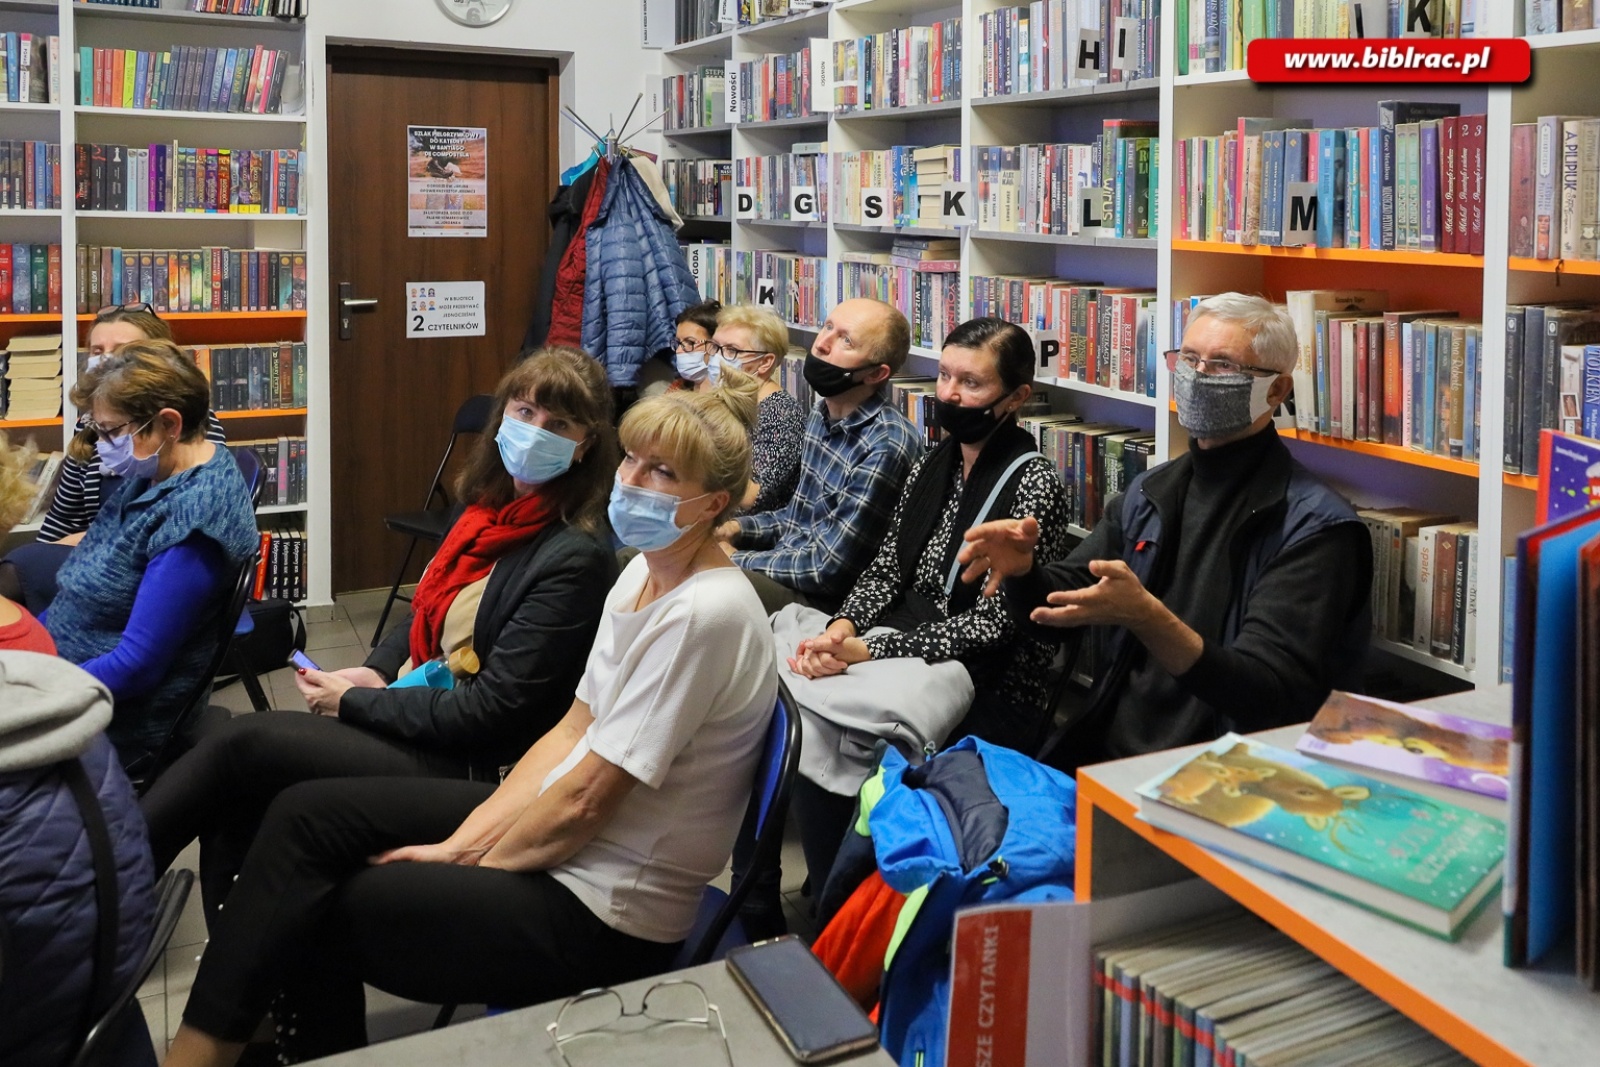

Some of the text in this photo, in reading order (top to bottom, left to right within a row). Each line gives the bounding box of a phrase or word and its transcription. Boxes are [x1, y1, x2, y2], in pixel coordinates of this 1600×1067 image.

[1407, 0, 1432, 33] K
[1078, 39, 1100, 70] H
[1118, 28, 1126, 58] I
[729, 72, 737, 113] Nowości
[1448, 126, 1453, 139] 1
[1461, 124, 1469, 137] 2
[1474, 124, 1482, 137] 3
[1564, 130, 1578, 191] A.PILIPIUK
[738, 194, 752, 212] D
[795, 193, 812, 214] G
[864, 195, 883, 219] S
[943, 190, 966, 216] K
[1083, 198, 1102, 228] L
[1290, 196, 1318, 231] M
[759, 285, 774, 305] K
[412, 315, 479, 332] 2 CZYTELNIKÓW
[1041, 340, 1059, 367] P
[1124, 323, 1133, 365] RELIKT
[1451, 331, 1464, 392] Nora Roberts
[1420, 547, 1431, 583] sparks
[977, 925, 1000, 1029] CZYTANKI
